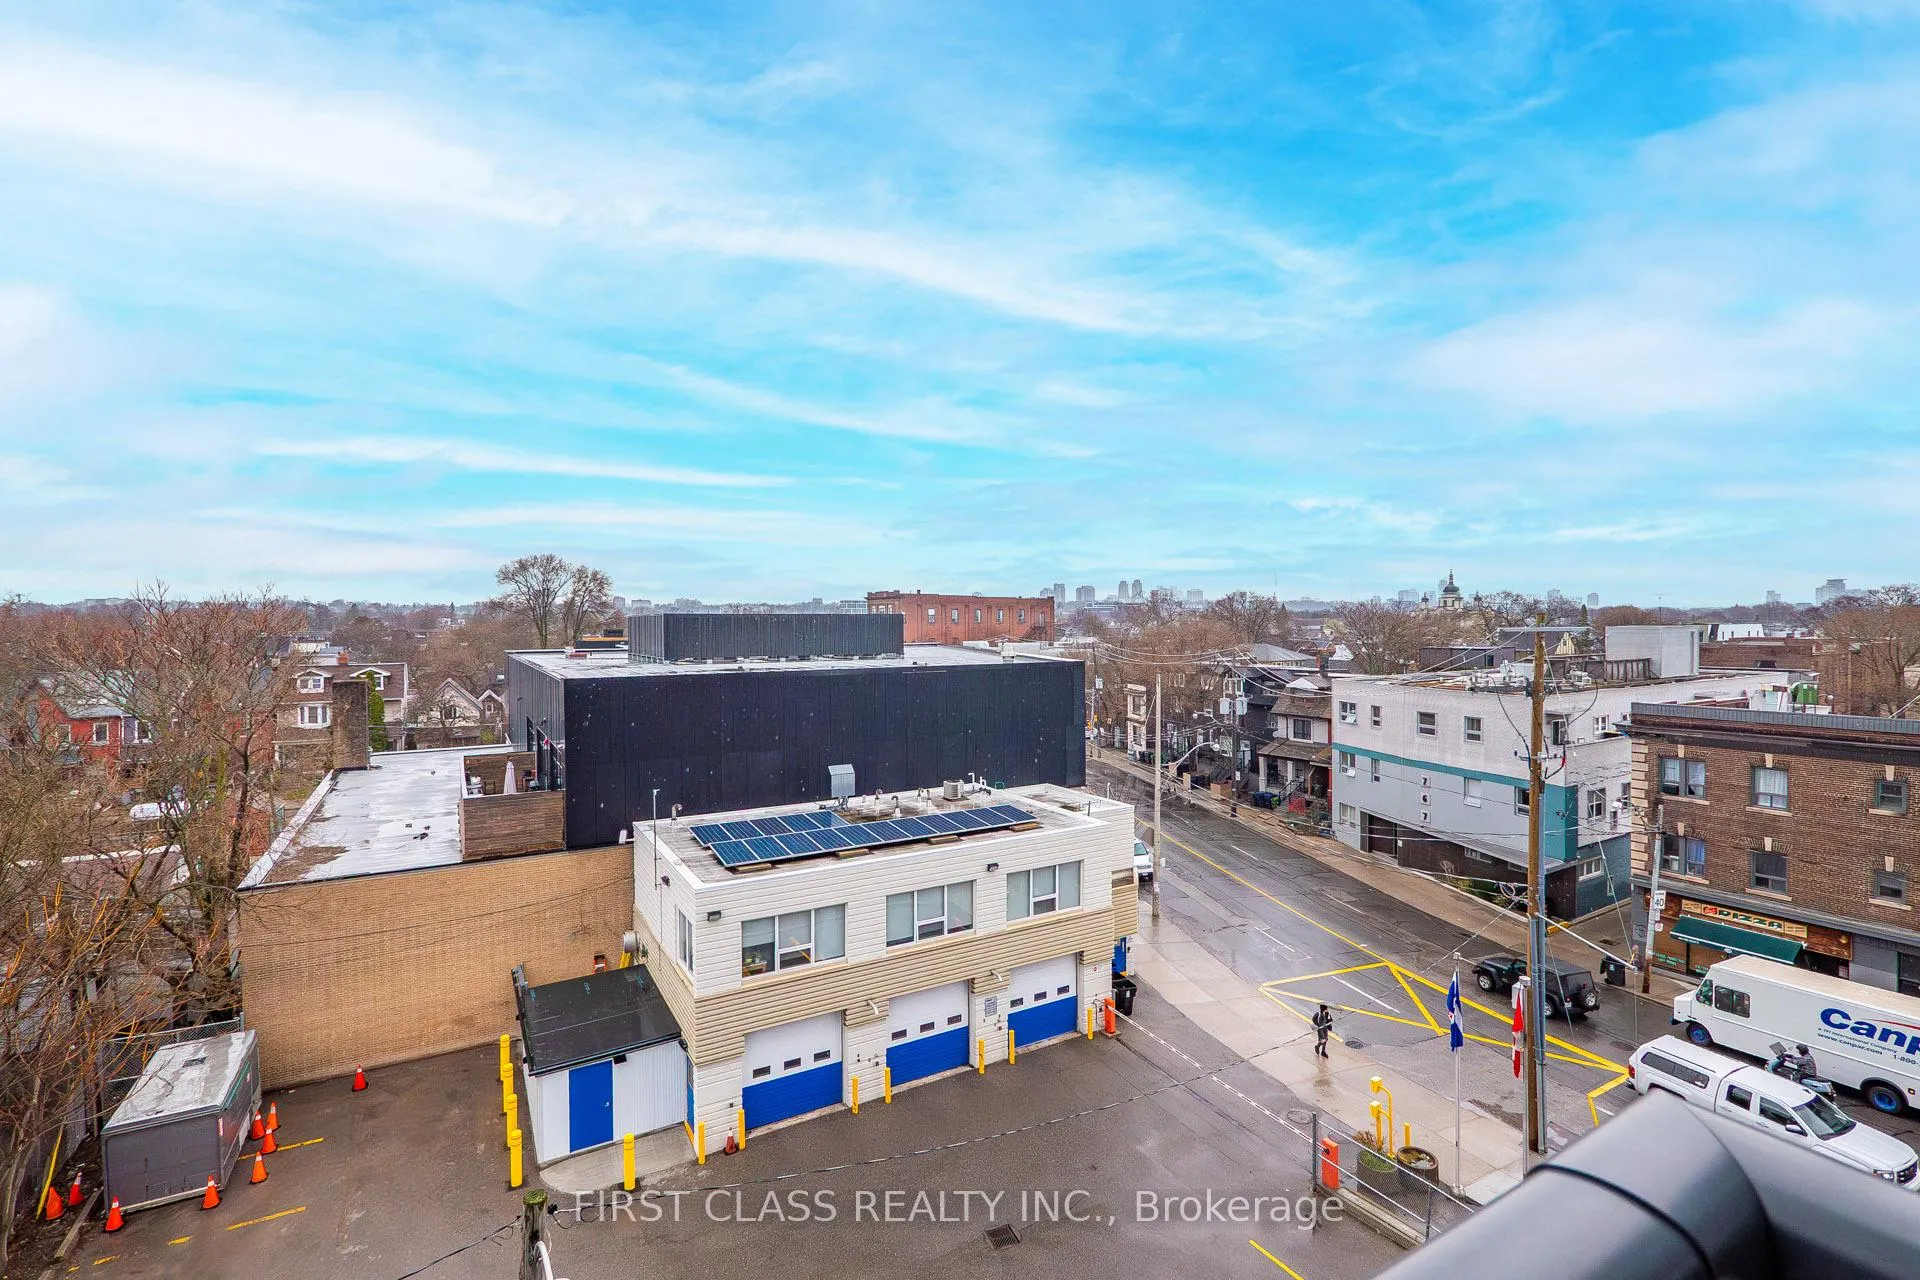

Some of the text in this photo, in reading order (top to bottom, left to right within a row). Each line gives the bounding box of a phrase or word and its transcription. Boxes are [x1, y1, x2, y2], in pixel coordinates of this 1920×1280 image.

[1654, 898, 1665, 907] 40
[1718, 909, 1783, 930] PIZZA
[1817, 1033, 1920, 1066] www.canpar.com 1-800-
[1831, 1031, 1870, 1045] International
[1870, 1042, 1898, 1053] Company
